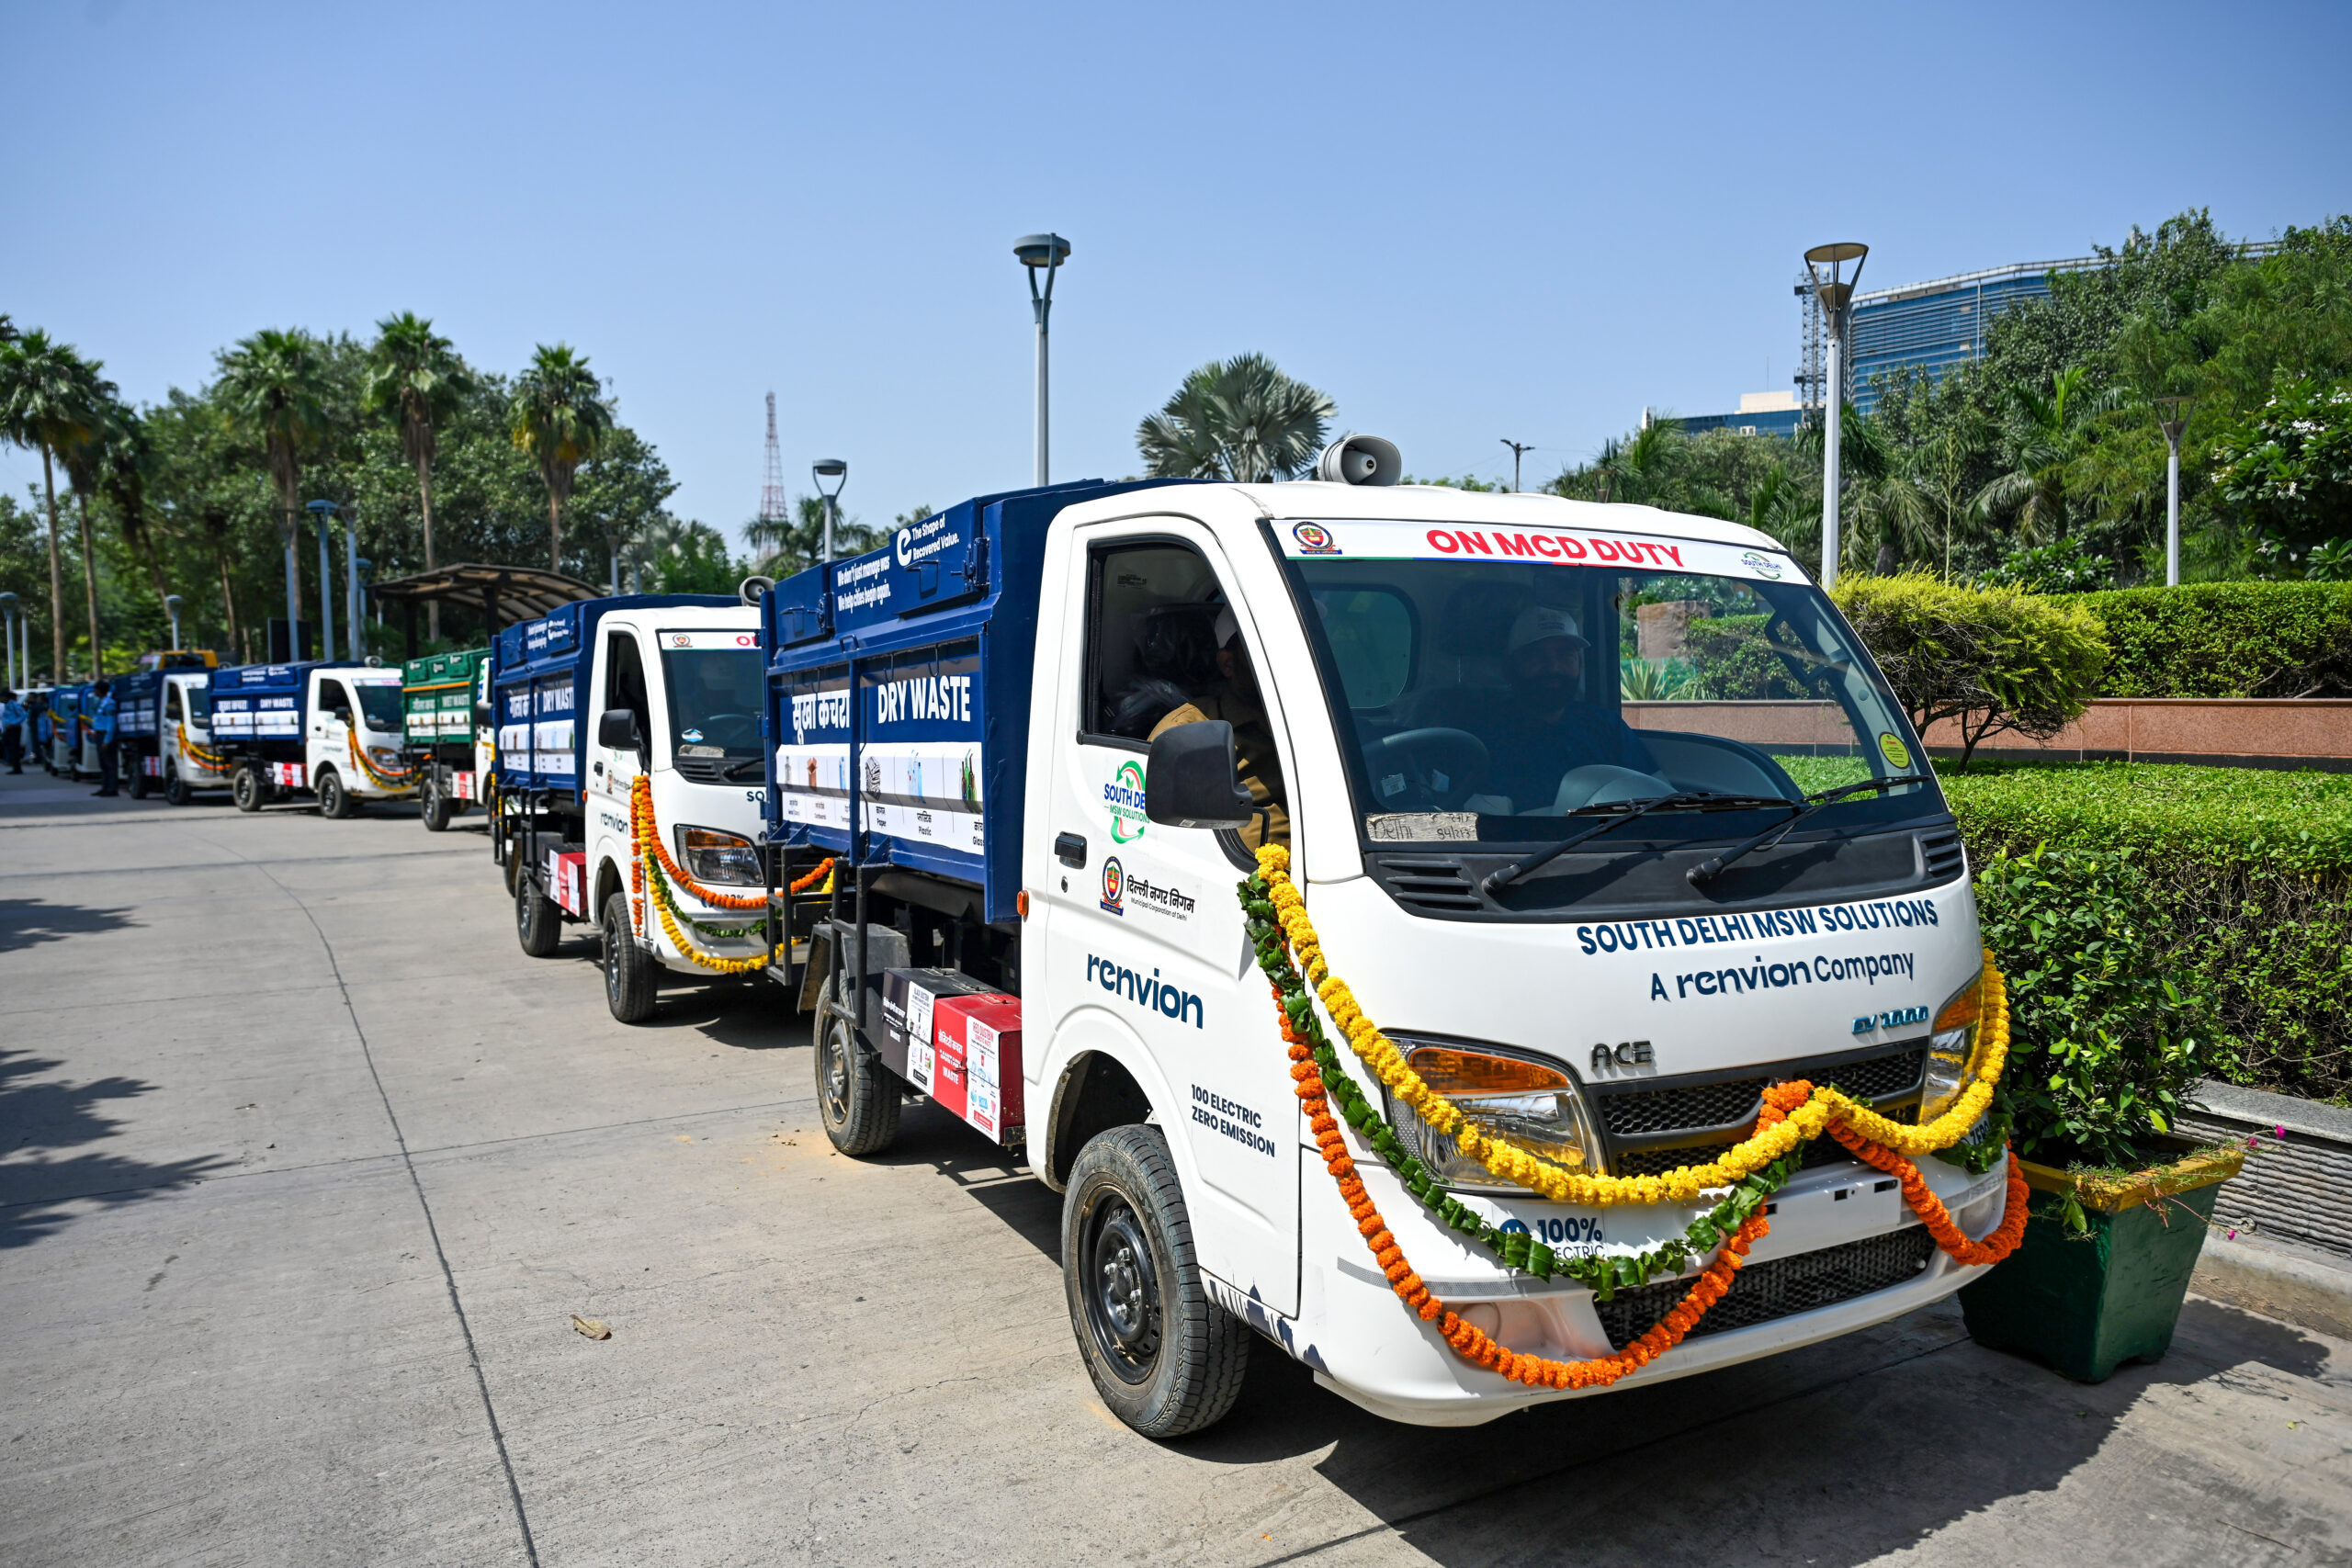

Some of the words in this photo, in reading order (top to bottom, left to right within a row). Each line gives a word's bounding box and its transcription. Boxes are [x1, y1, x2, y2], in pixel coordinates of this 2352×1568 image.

[912, 527, 922, 541] The
[922, 519, 939, 537] Shape
[939, 513, 945, 528] of
[912, 536, 940, 560] Recovered
[940, 532, 959, 549] Value.
[1426, 529, 1494, 555] ON
[1492, 532, 1585, 561] MCD
[1587, 538, 1685, 568] DUTY
[1741, 558, 1763, 568] SOUTH
[877, 680, 908, 724] DRY
[910, 675, 971, 722] WASTE
[792, 693, 817, 745] सूखा
[818, 689, 851, 728] कचरा
[1104, 783, 1133, 807] SOUTH
[601, 812, 628, 835] renvion
[1109, 804, 1122, 816] MSW
[918, 826, 933, 837] Plastic
[1126, 874, 1149, 898] दिल्ली
[1149, 886, 1169, 905] नगर
[1170, 887, 1195, 914] निगम
[1131, 897, 1148, 908] Municipal
[1148, 903, 1172, 916] Corporation
[1177, 912, 1188, 921] Delhi
[1577, 920, 1677, 955] SOUTH
[1675, 913, 1754, 945] DELHI
[1750, 908, 1818, 938] MSW
[1818, 898, 1939, 932] SOLUTIONS
[1087, 953, 1203, 1029] renvion
[1651, 973, 1669, 1001] A
[1675, 955, 1812, 998] renvion
[1815, 952, 1913, 986] Company
[1851, 1015, 1878, 1034] EV
[1879, 1005, 1929, 1029] 1000
[1591, 1040, 1653, 1070] ACE
[1191, 1084, 1209, 1105] 100
[1211, 1093, 1261, 1129] ELECTRIC
[1192, 1105, 1219, 1130] ZERO
[1220, 1120, 1275, 1157] EMISSION
[1537, 1217, 1603, 1244] 100%
[1554, 1245, 1606, 1261] ECTRIC
